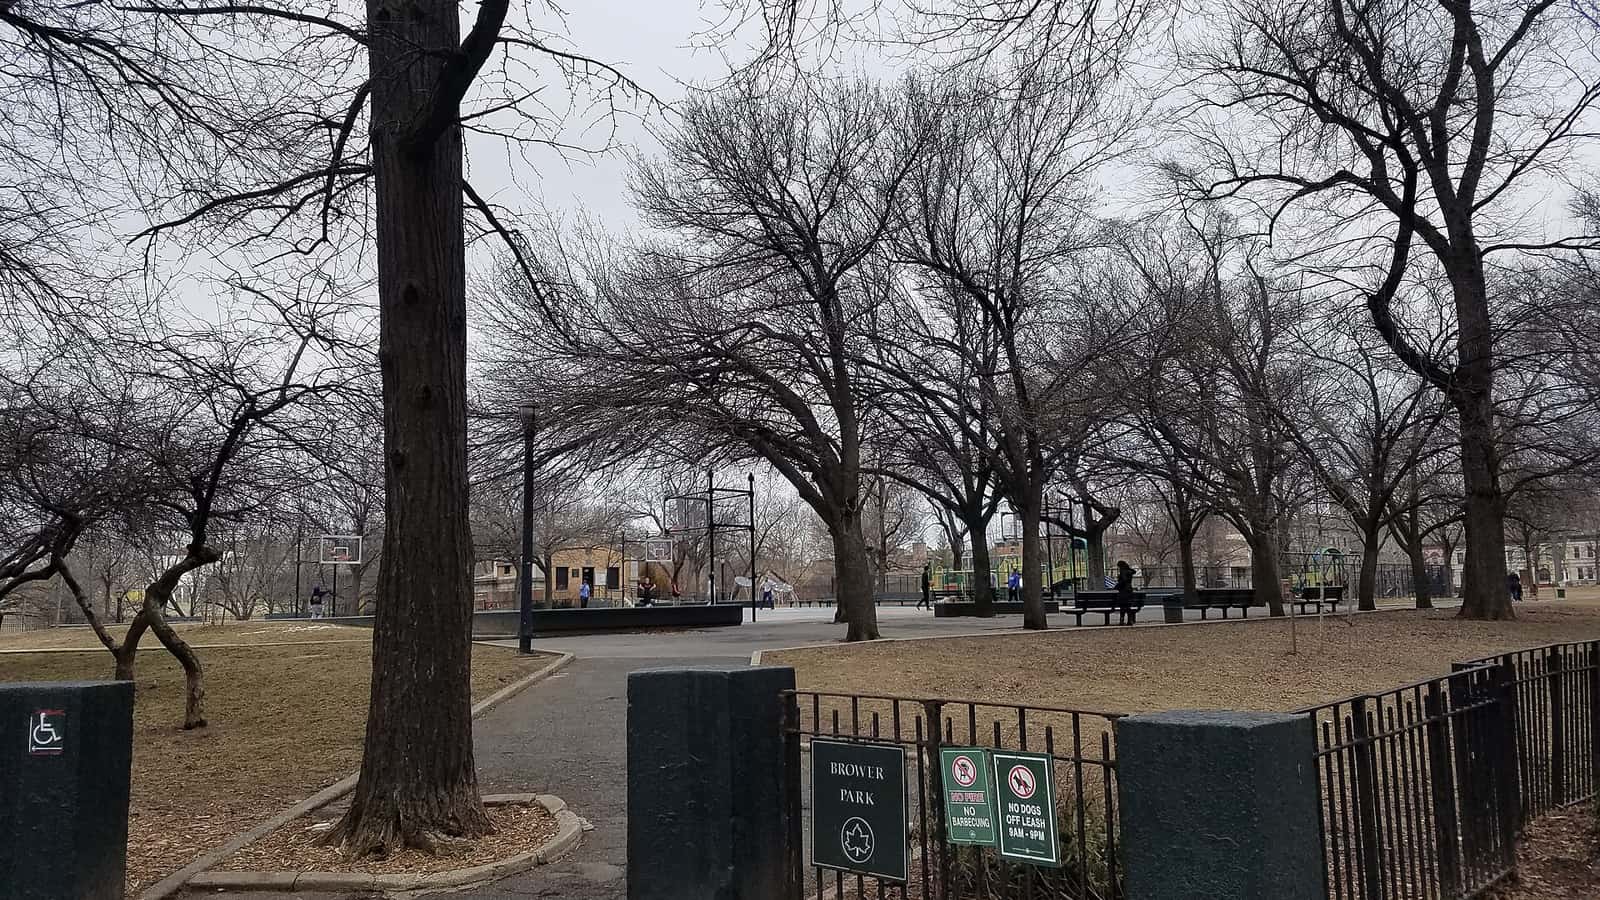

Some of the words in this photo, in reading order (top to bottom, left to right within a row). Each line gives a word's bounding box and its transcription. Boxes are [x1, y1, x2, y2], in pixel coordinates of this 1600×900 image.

[831, 762, 884, 780] BROWER
[840, 789, 874, 805] PARK
[964, 807, 975, 816] NO
[1008, 803, 1019, 814] NO
[1020, 804, 1041, 815] DOGS
[953, 816, 990, 828] BARBECUING
[1007, 814, 1020, 825] OFF
[1021, 816, 1045, 828] LEASH
[1009, 827, 1024, 838] 9AM
[1030, 829, 1044, 840] 9PM
